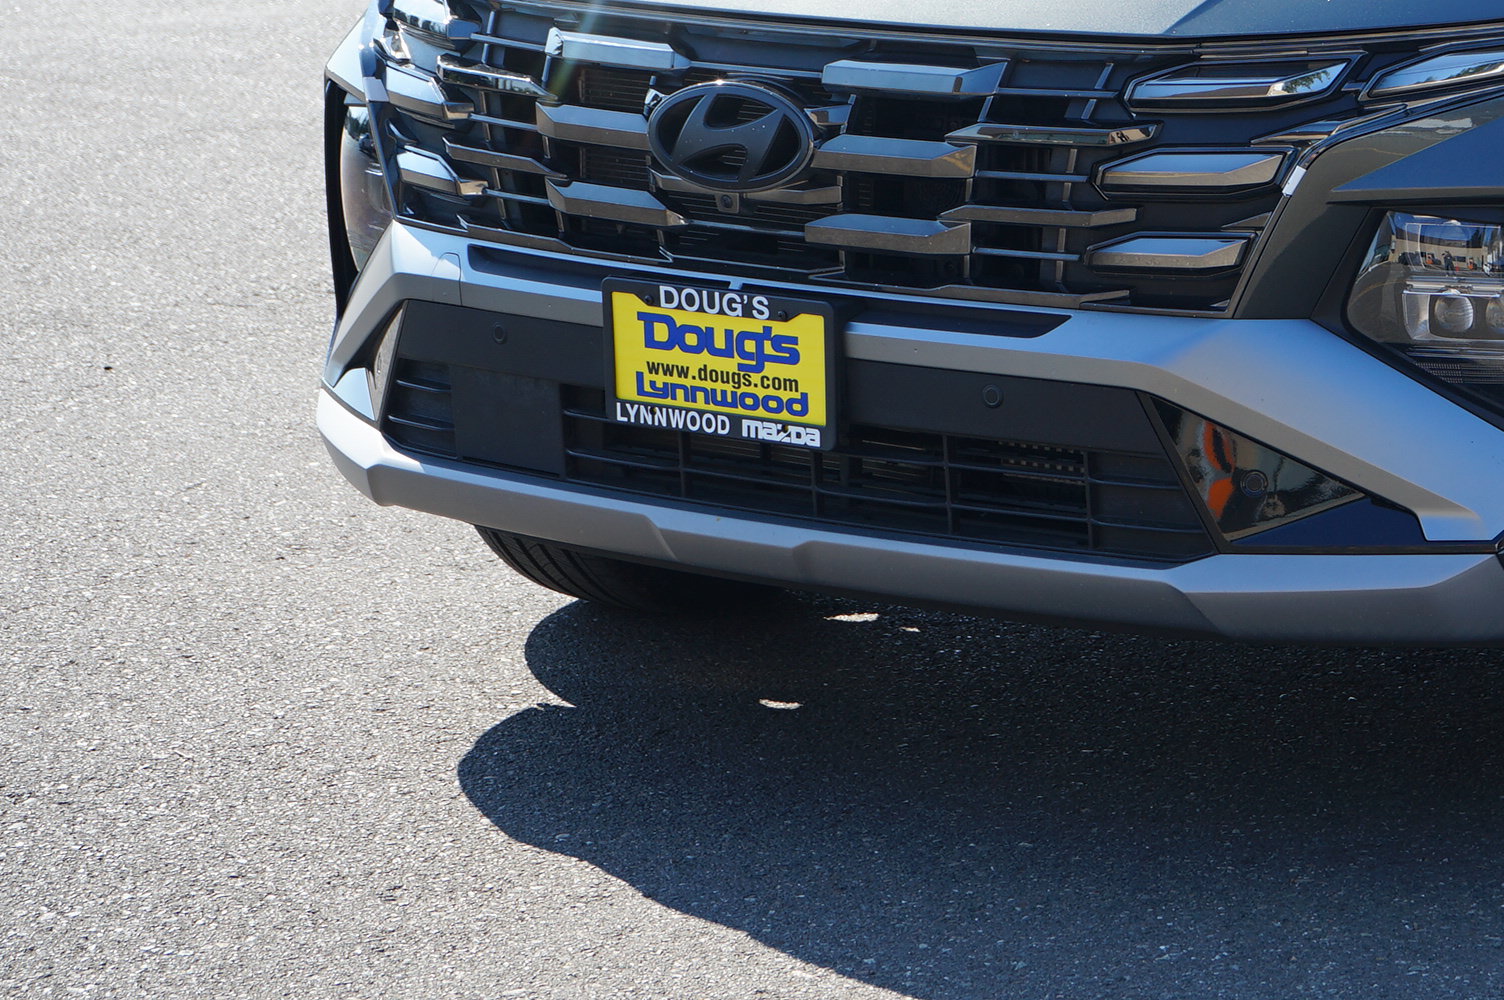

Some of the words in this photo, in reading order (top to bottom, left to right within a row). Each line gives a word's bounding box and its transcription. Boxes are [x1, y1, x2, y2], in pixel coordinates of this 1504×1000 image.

[658, 285, 770, 320] DOUG'S
[646, 360, 799, 393] www.dougs.com
[635, 371, 809, 417] Lynnwood
[616, 402, 731, 435] LYNNWOOD
